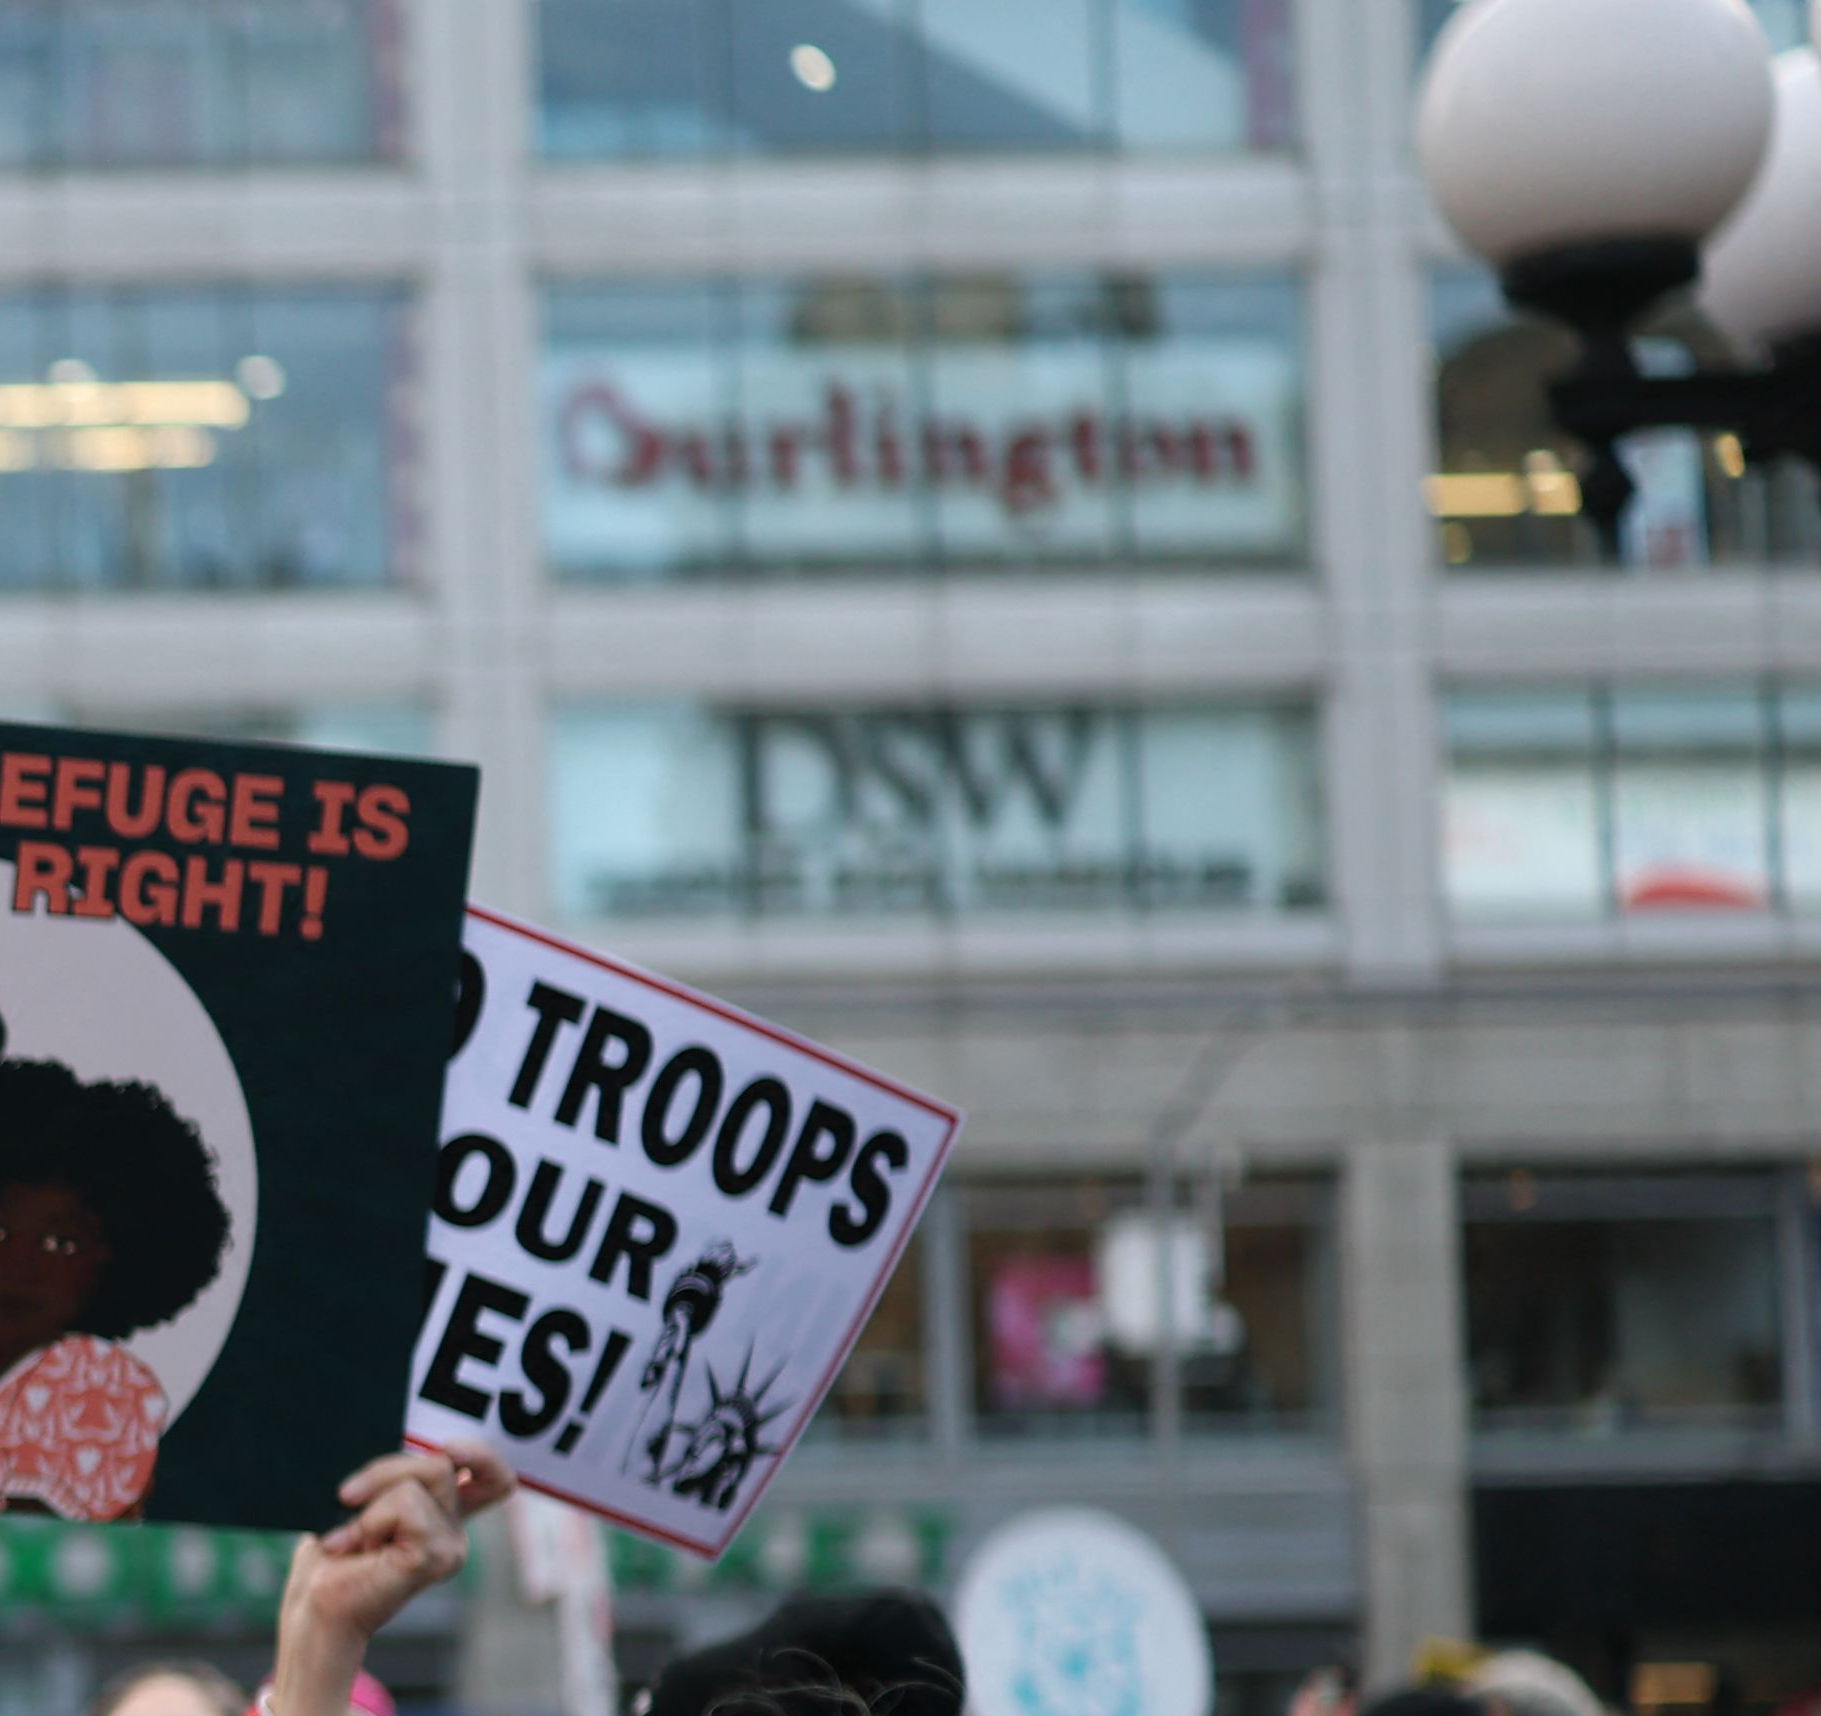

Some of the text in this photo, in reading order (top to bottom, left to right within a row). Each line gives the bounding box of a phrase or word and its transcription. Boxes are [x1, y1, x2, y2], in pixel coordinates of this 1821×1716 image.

[308, 782, 410, 858] IS
[727, 710, 1099, 838] DSW
[15, 842, 328, 940] RIGHT!
[508, 979, 909, 1249] TROOPS
[431, 1132, 679, 1302] OUR
